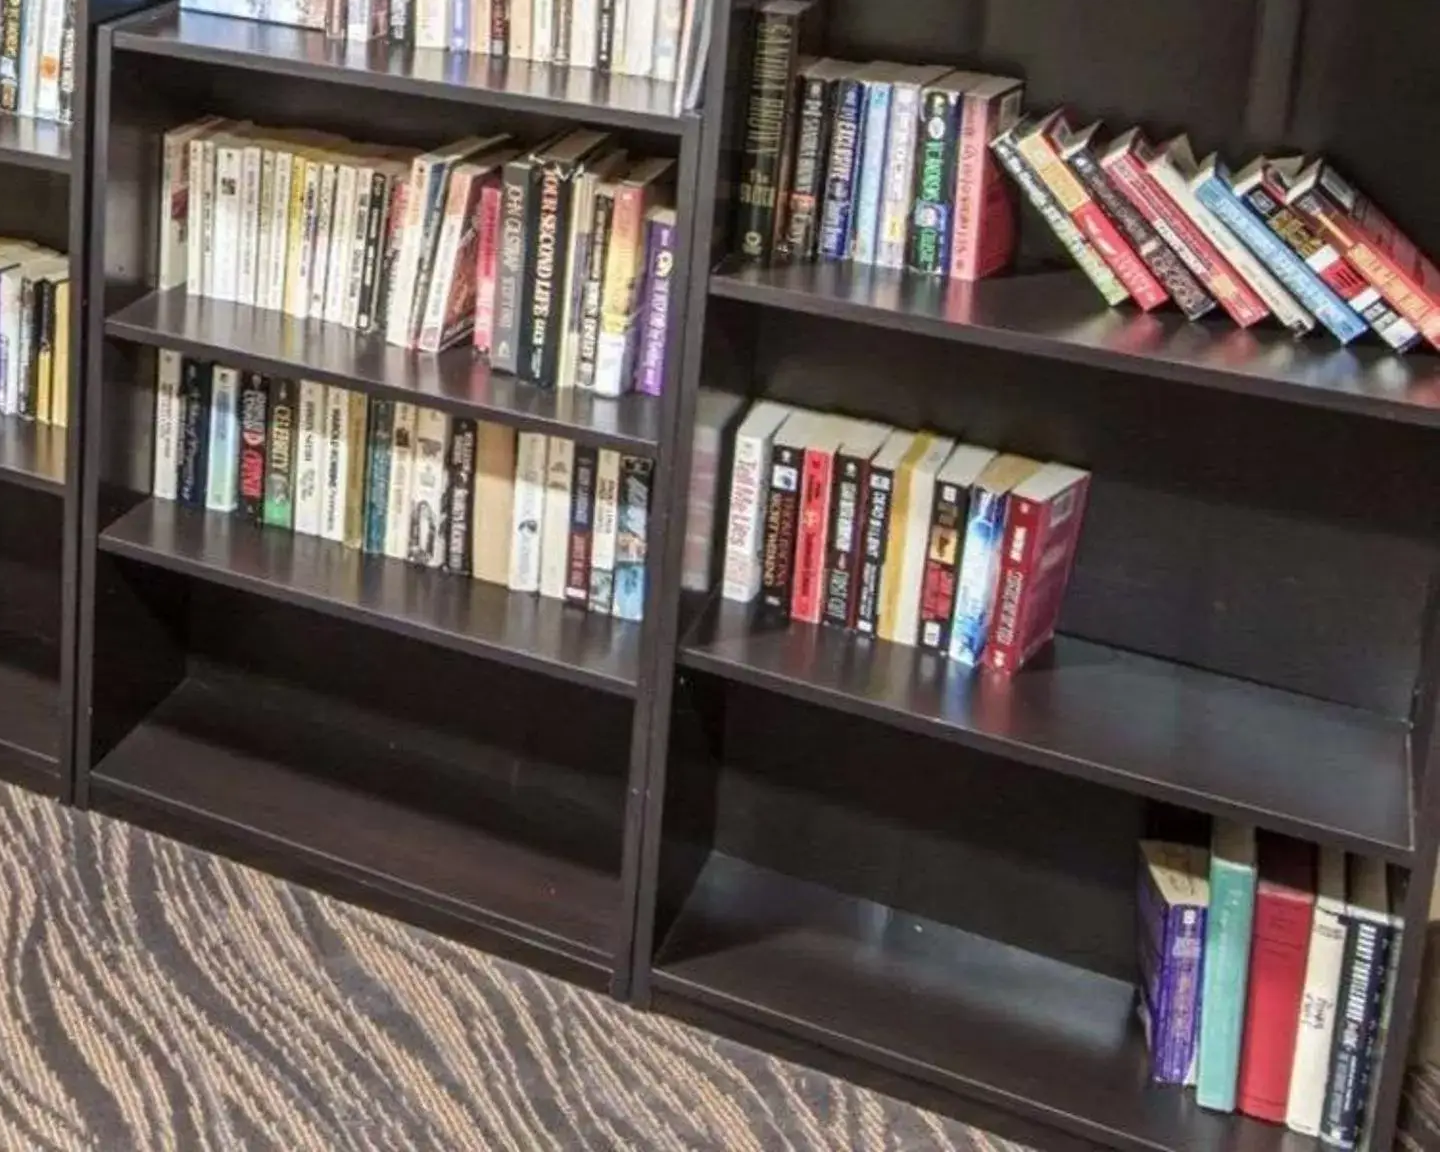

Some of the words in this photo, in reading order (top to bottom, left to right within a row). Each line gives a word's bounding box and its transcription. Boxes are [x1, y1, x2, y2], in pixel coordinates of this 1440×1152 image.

[751, 22, 793, 91] SANDRA
[745, 95, 785, 155] BROWN
[535, 213, 558, 279] SECOND
[532, 279, 554, 317] LIFE
